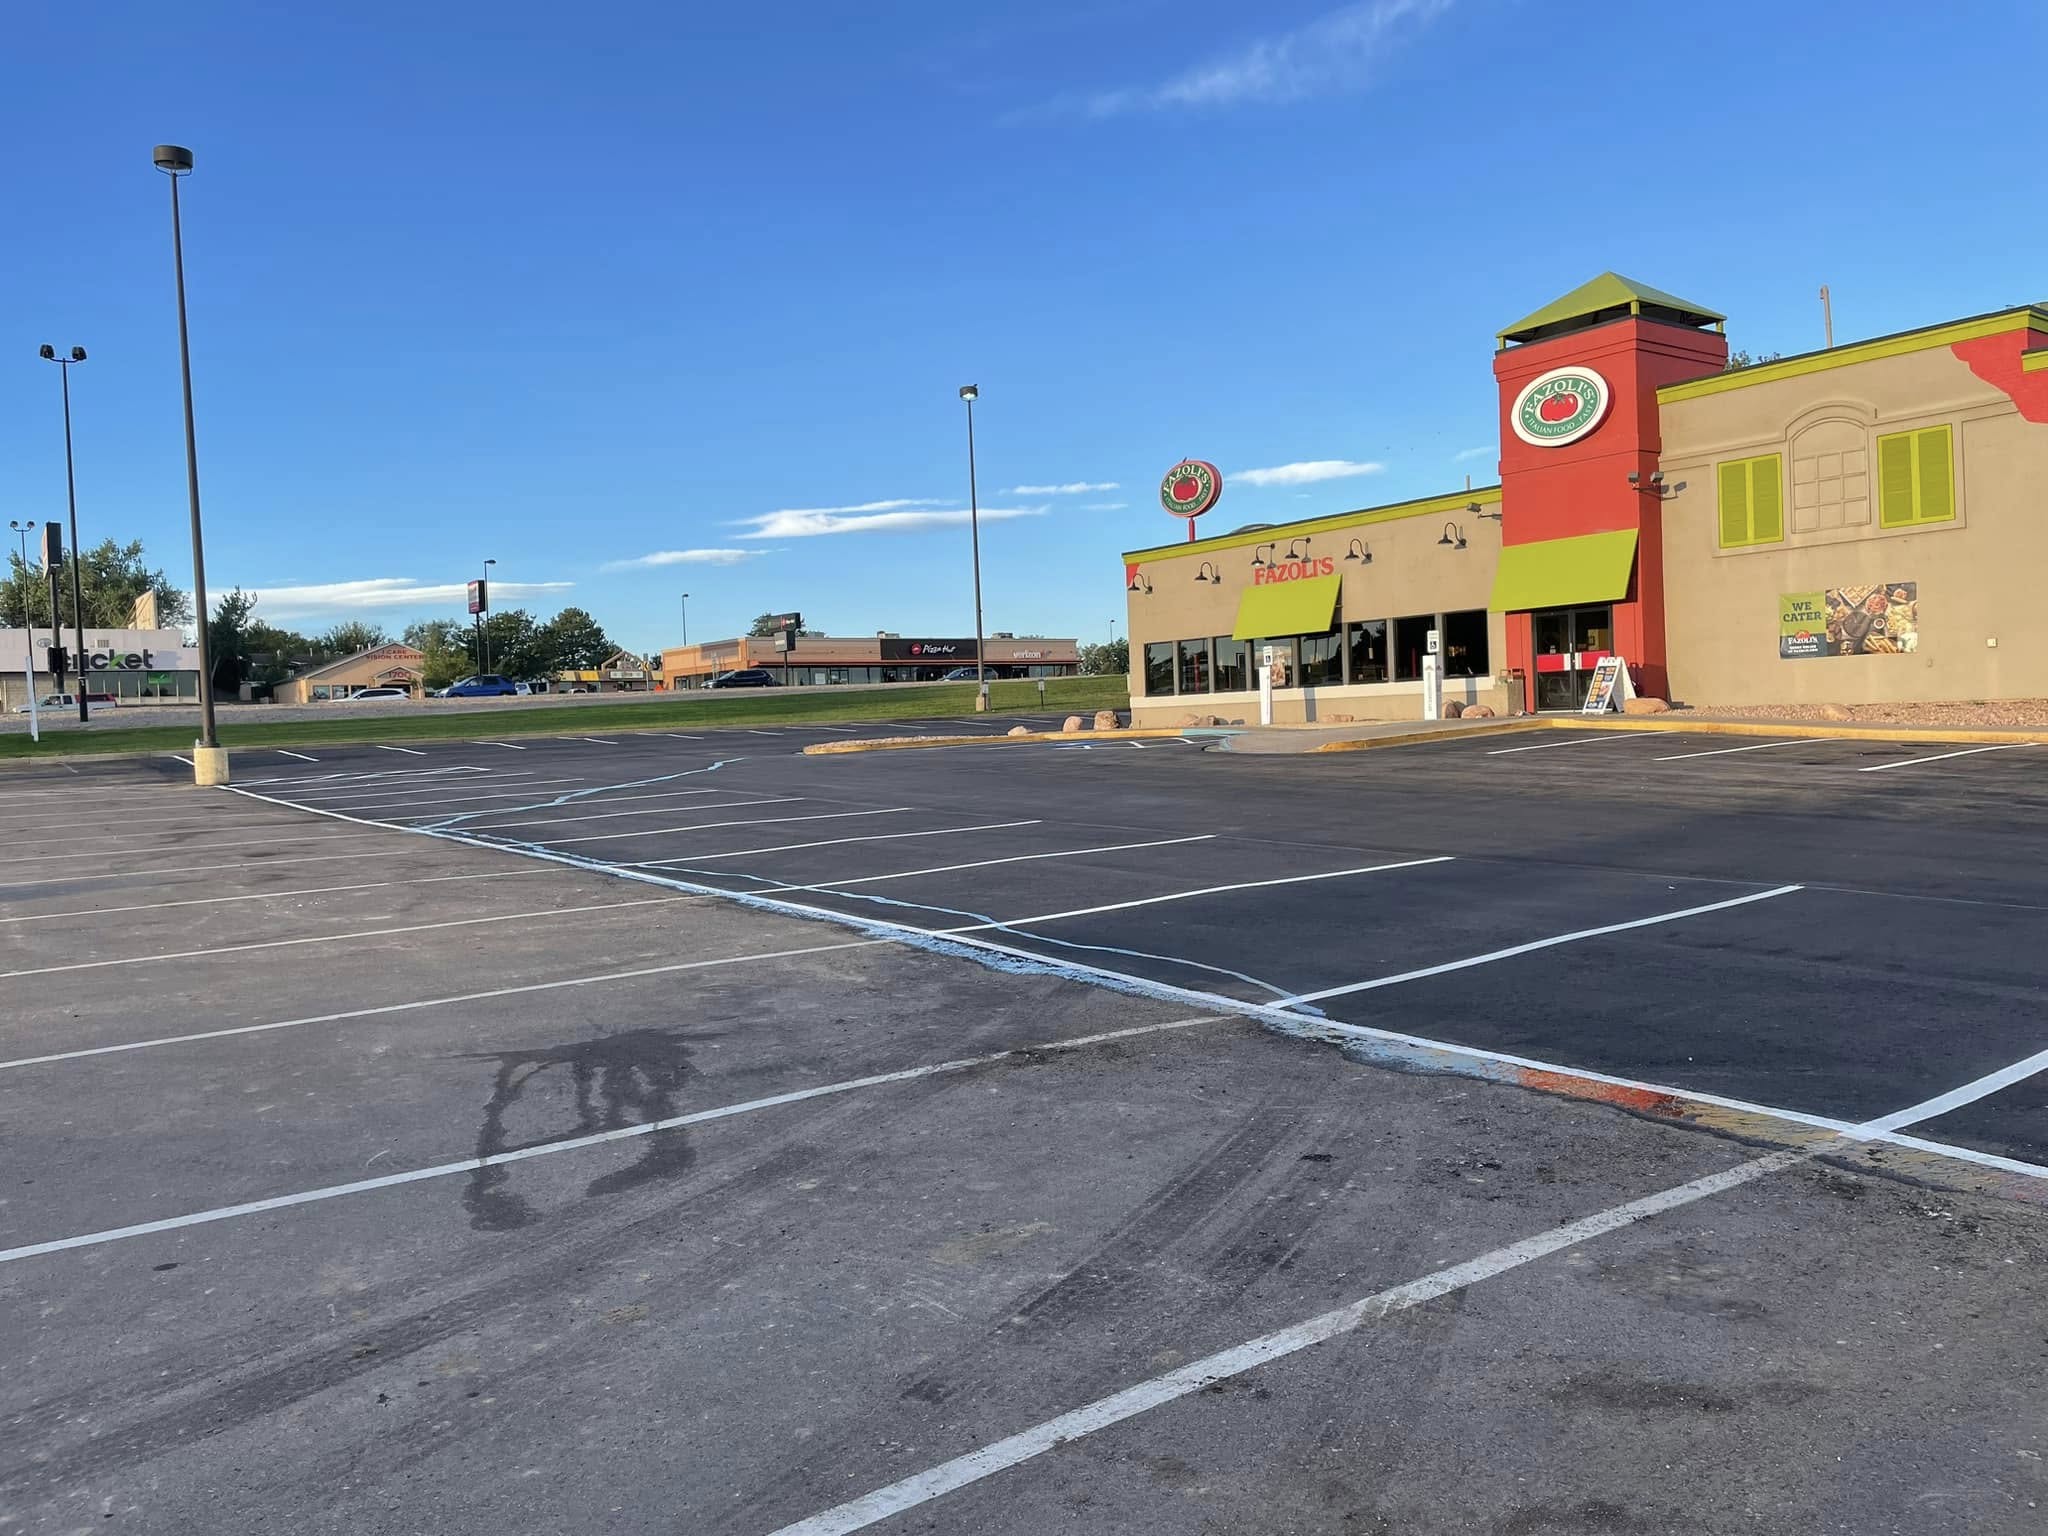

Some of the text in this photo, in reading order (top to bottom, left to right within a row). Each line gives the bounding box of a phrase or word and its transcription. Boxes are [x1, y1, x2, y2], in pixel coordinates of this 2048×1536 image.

[1525, 379, 1594, 414] FAZOLI'S
[1163, 465, 1209, 492] FAZOLI'S
[1254, 557, 1335, 586] FAZOLI'S
[1783, 611, 1822, 622] CATER
[1792, 601, 1812, 611] WE
